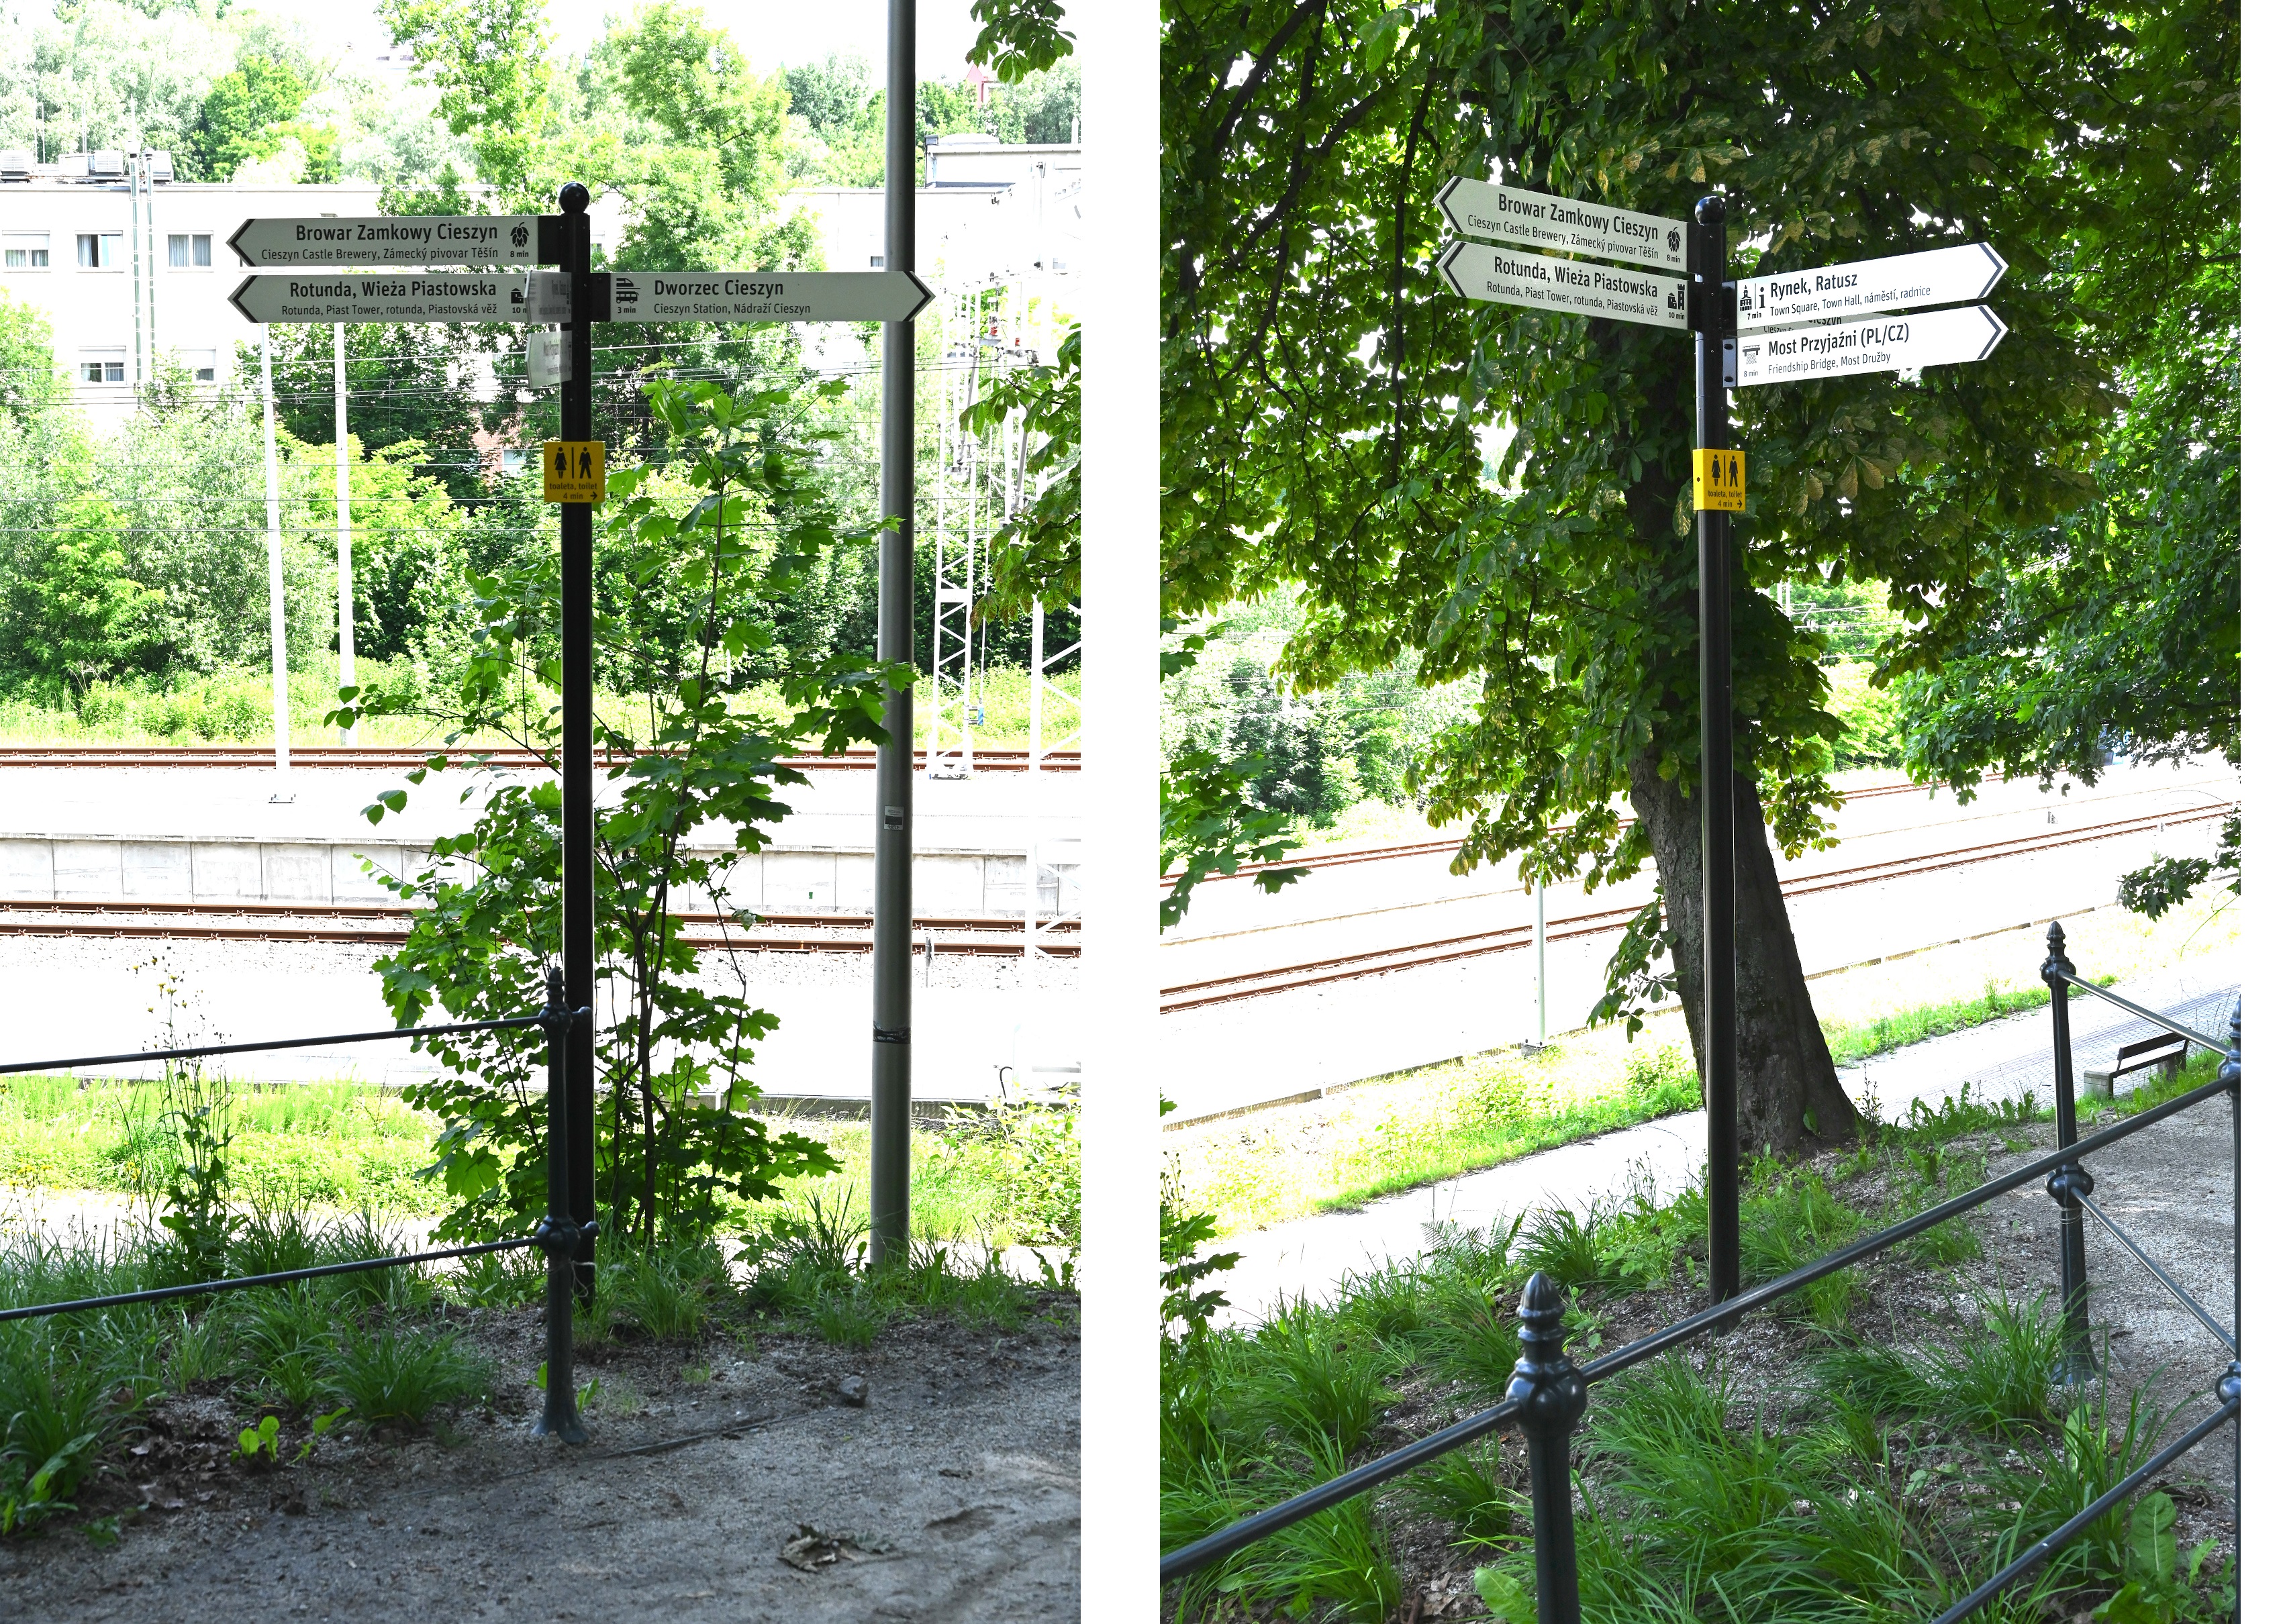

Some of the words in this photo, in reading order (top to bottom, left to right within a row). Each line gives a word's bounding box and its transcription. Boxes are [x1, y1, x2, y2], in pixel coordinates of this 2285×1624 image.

[1498, 193, 1546, 219] Browar
[1550, 203, 1610, 235] Zamkowy
[1613, 215, 1658, 243] Cieszyn
[296, 225, 352, 241] Browar
[357, 223, 432, 244] Zamkowy
[437, 223, 497, 242] Cieszyn
[1467, 214, 1501, 233] Cieszyn
[1504, 221, 1530, 237] Castle
[1533, 226, 1569, 246] Brewery,
[1571, 233, 1606, 252] Zámecký
[1608, 240, 1637, 255] pivovar
[1638, 245, 1659, 259] Těšín
[261, 249, 299, 262] Cieszyn
[302, 248, 333, 260] Castle
[336, 248, 381, 262] Brewery,
[383, 247, 428, 261] Zámecký
[430, 248, 469, 261] pivovar
[471, 247, 498, 258] Těšín
[1666, 254, 1671, 262] 8
[1671, 255, 1681, 263] min
[1494, 256, 1551, 284] Rotunda,
[1554, 266, 1590, 287] Wieża
[1594, 272, 1657, 298] Piastowska
[290, 281, 356, 299] Rotunda,
[361, 281, 406, 297] Wieża
[411, 280, 496, 297] Piastowska
[654, 280, 720, 295] Dworzec
[724, 279, 783, 299] Cieszyn
[1771, 277, 1811, 301] Rynek,
[1816, 274, 1857, 291] Ratusz
[1487, 281, 1523, 298] Rotunda,
[1525, 287, 1545, 300] Piast
[1546, 292, 1572, 305] Tower,
[1574, 295, 1605, 310] rotunda,
[1607, 299, 1645, 314] Piastovská
[1646, 305, 1658, 316] věž
[1769, 306, 1790, 316] Town
[1791, 303, 1820, 315] Square,
[1822, 299, 1842, 309] Town
[1845, 294, 1862, 306] Hall,
[1864, 289, 1898, 303] náměstí,
[1900, 285, 1931, 299] radnice
[282, 305, 324, 316] Rotunda,
[326, 305, 350, 315] Piast
[351, 305, 383, 316] Tower,
[386, 304, 426, 315] rotunda,
[428, 303, 479, 314] Piastovská
[481, 303, 497, 314] věž
[654, 303, 690, 316] Cieszyn
[693, 303, 731, 315] Station,
[734, 303, 772, 313] Nádraží
[773, 303, 810, 316] Cieszyn
[1675, 312, 1685, 320] min
[1751, 311, 1762, 319] min
[1769, 339, 1797, 356] Most
[1801, 329, 1857, 354] Przyjaźni
[1861, 322, 1909, 348] (PL/CZ)
[1768, 360, 1808, 374] Friendship
[1810, 358, 1839, 370] Bridge,
[1841, 355, 1860, 366] Most
[1862, 351, 1891, 364] Družby
[549, 482, 577, 491] toaleta,
[578, 482, 597, 490] toilet
[563, 492, 568, 500] 4
[570, 492, 583, 500] min
[1708, 489, 1728, 499] toaleta,
[1729, 490, 1743, 498] toilet
[1718, 499, 1722, 507] 4
[1722, 499, 1733, 507] min
